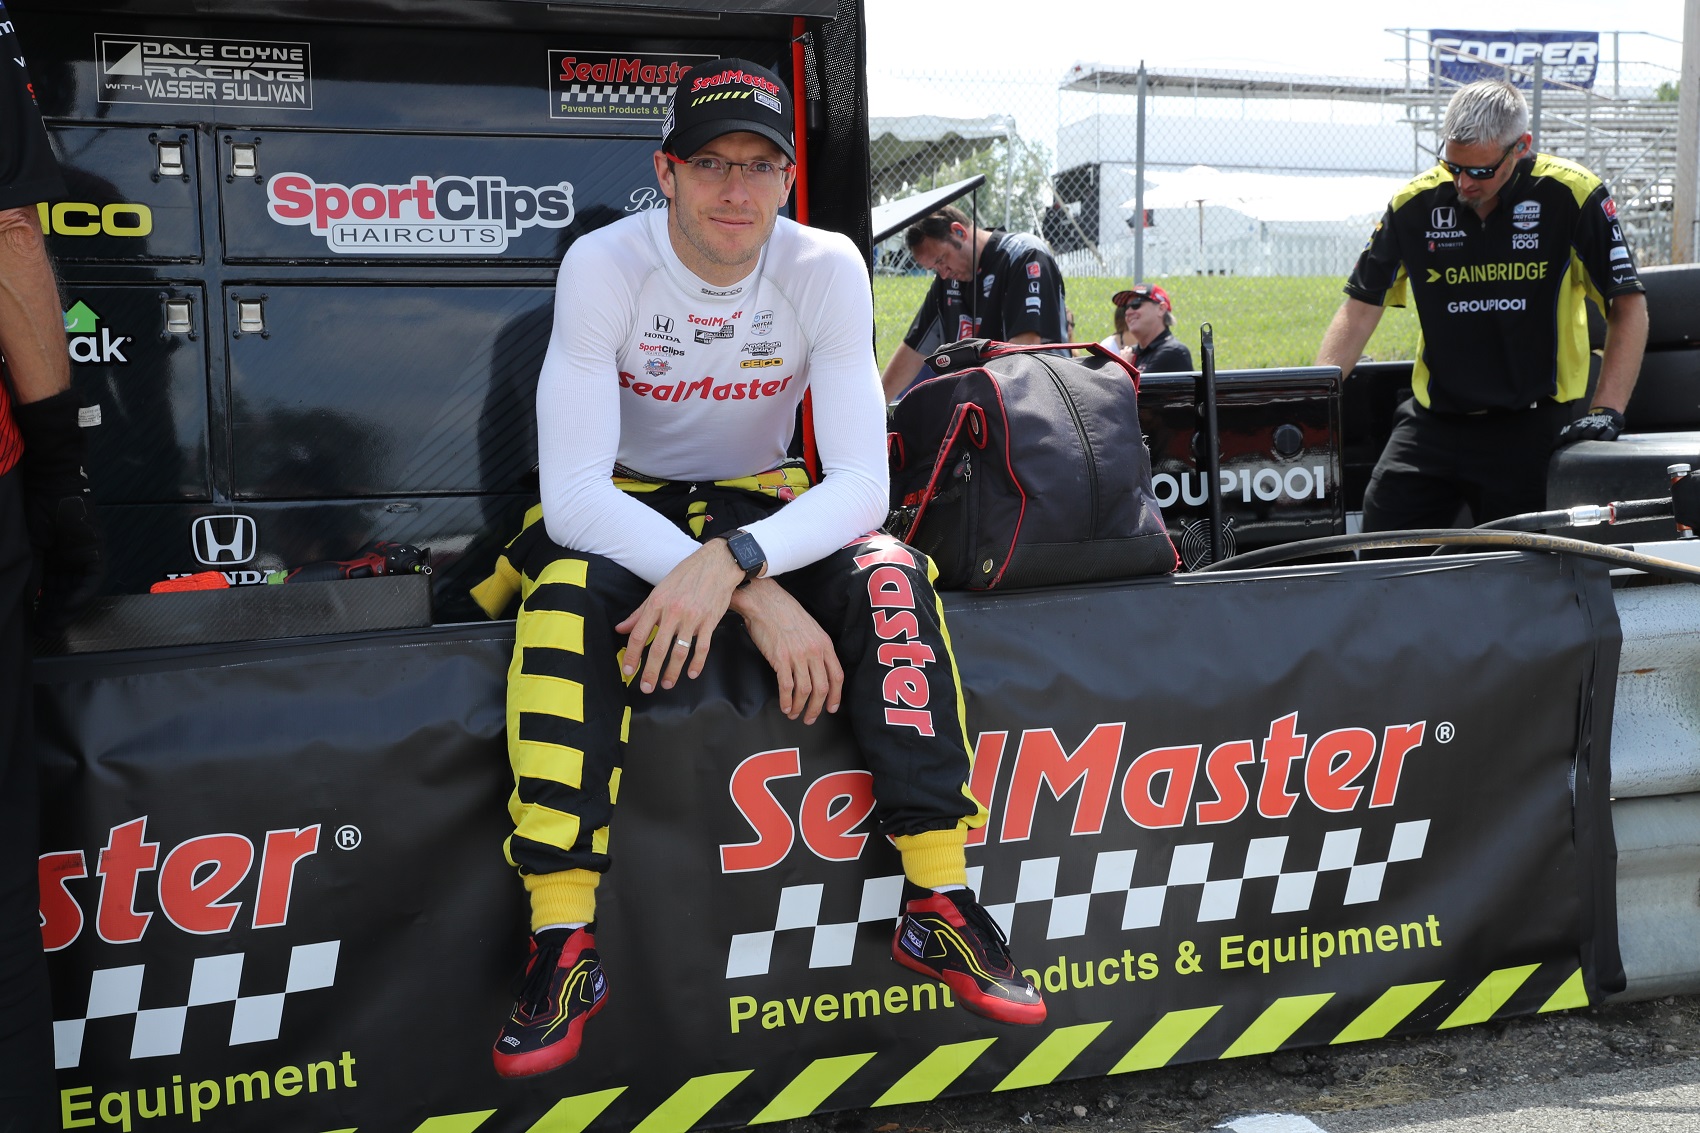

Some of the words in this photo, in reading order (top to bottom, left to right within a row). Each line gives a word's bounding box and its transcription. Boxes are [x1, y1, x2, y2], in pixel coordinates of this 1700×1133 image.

[143, 42, 214, 58] DALE
[221, 45, 303, 62] COYNE
[1429, 38, 1598, 65] COOPER
[143, 65, 305, 83] RACING
[560, 57, 694, 85] SealMast
[105, 83, 143, 91] WITH
[144, 78, 217, 100] VASSER
[222, 82, 305, 105] SULLIVAN
[691, 71, 780, 96] SealMaster
[561, 105, 606, 113] Pavement
[609, 105, 650, 115] Products
[652, 106, 661, 114] &
[272, 176, 570, 229] SportClips
[340, 228, 496, 243] HAIRCUTS
[1425, 230, 1467, 239] HONDA
[1512, 239, 1539, 249] 1001
[1445, 261, 1548, 285] GAINBRIDGE
[1447, 298, 1526, 313] GROUP1001
[644, 332, 681, 343] HONDA
[639, 343, 686, 357] SportClips
[740, 358, 783, 369] GEICO
[619, 371, 793, 402] SealMaster
[719, 710, 1427, 874] SelMaster
[729, 983, 955, 1034] Pavement
[1174, 940, 1203, 975] &
[1219, 914, 1442, 974] Equipment
[60, 1050, 358, 1133] Equipment
